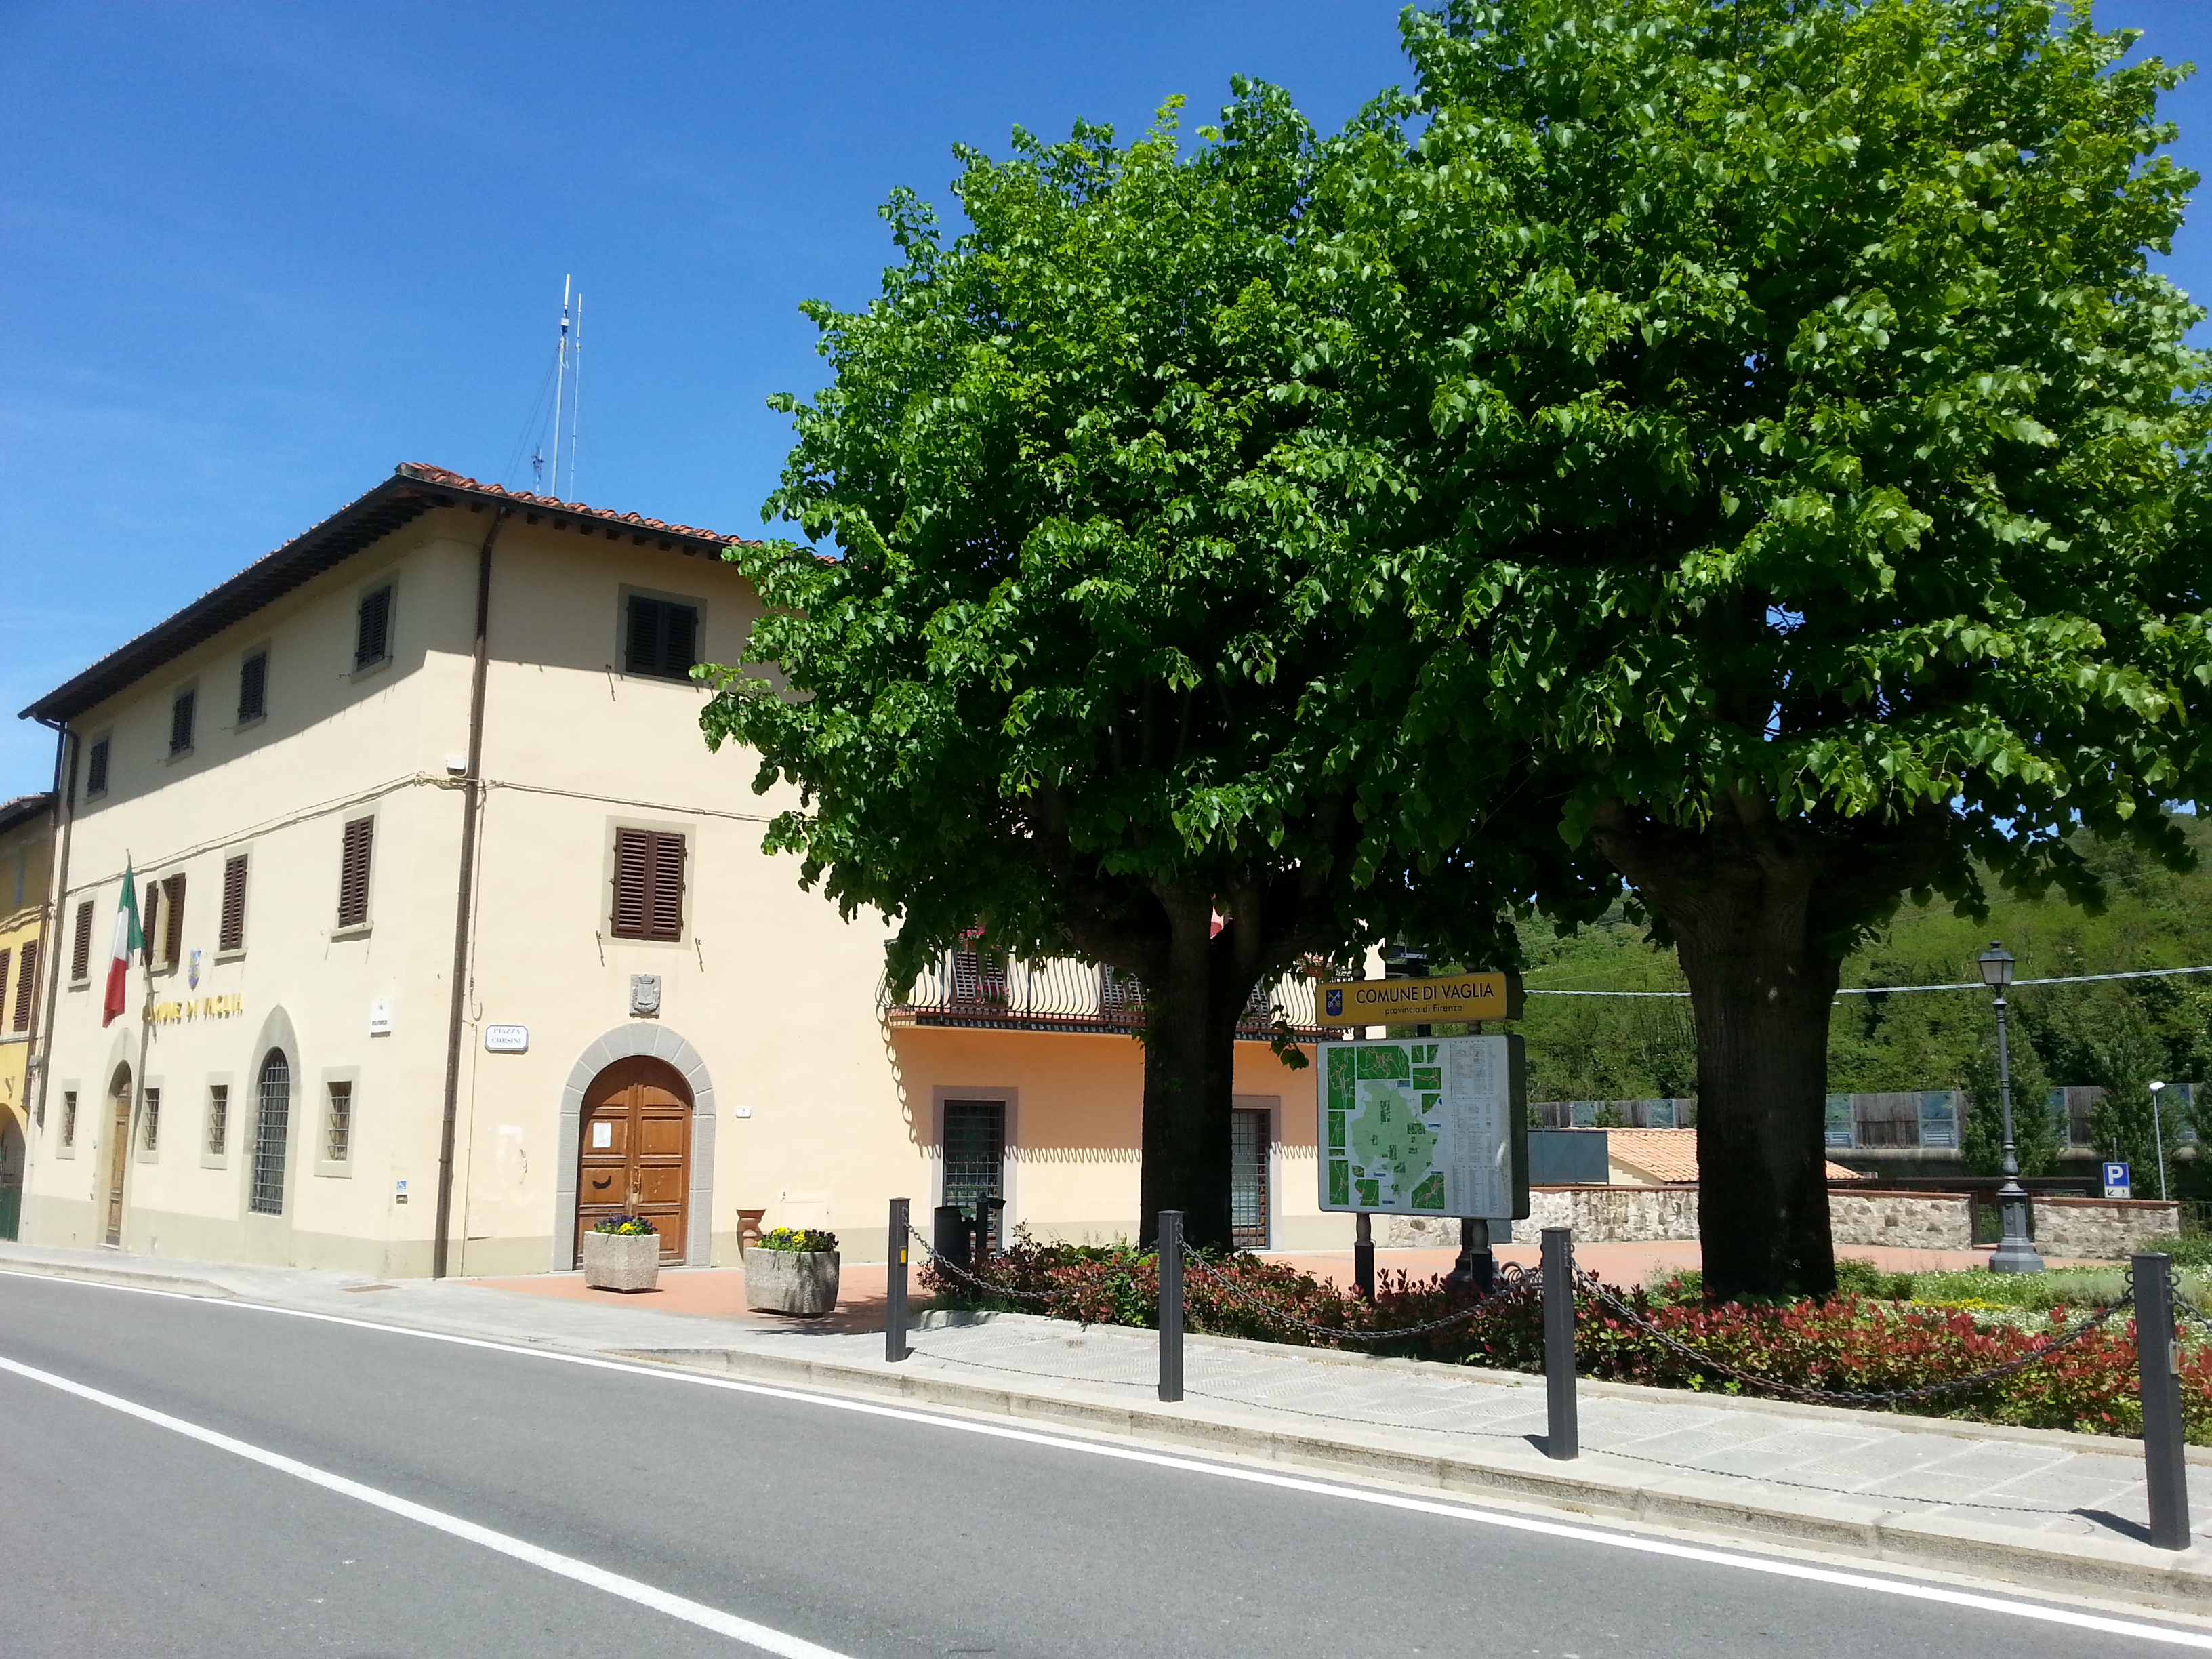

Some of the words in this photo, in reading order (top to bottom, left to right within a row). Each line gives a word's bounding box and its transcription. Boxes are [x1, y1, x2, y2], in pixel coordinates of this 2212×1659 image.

[1356, 987, 1418, 1004] COMUNE
[1423, 985, 1437, 1000] DI
[1441, 983, 1494, 999] VAGLIA
[142, 1002, 183, 1022] CMUNE
[1385, 1005, 1420, 1017] provincia
[1423, 1004, 1430, 1013] di
[1433, 1004, 1462, 1012] Firenze
[2108, 1165, 2124, 1185] P
